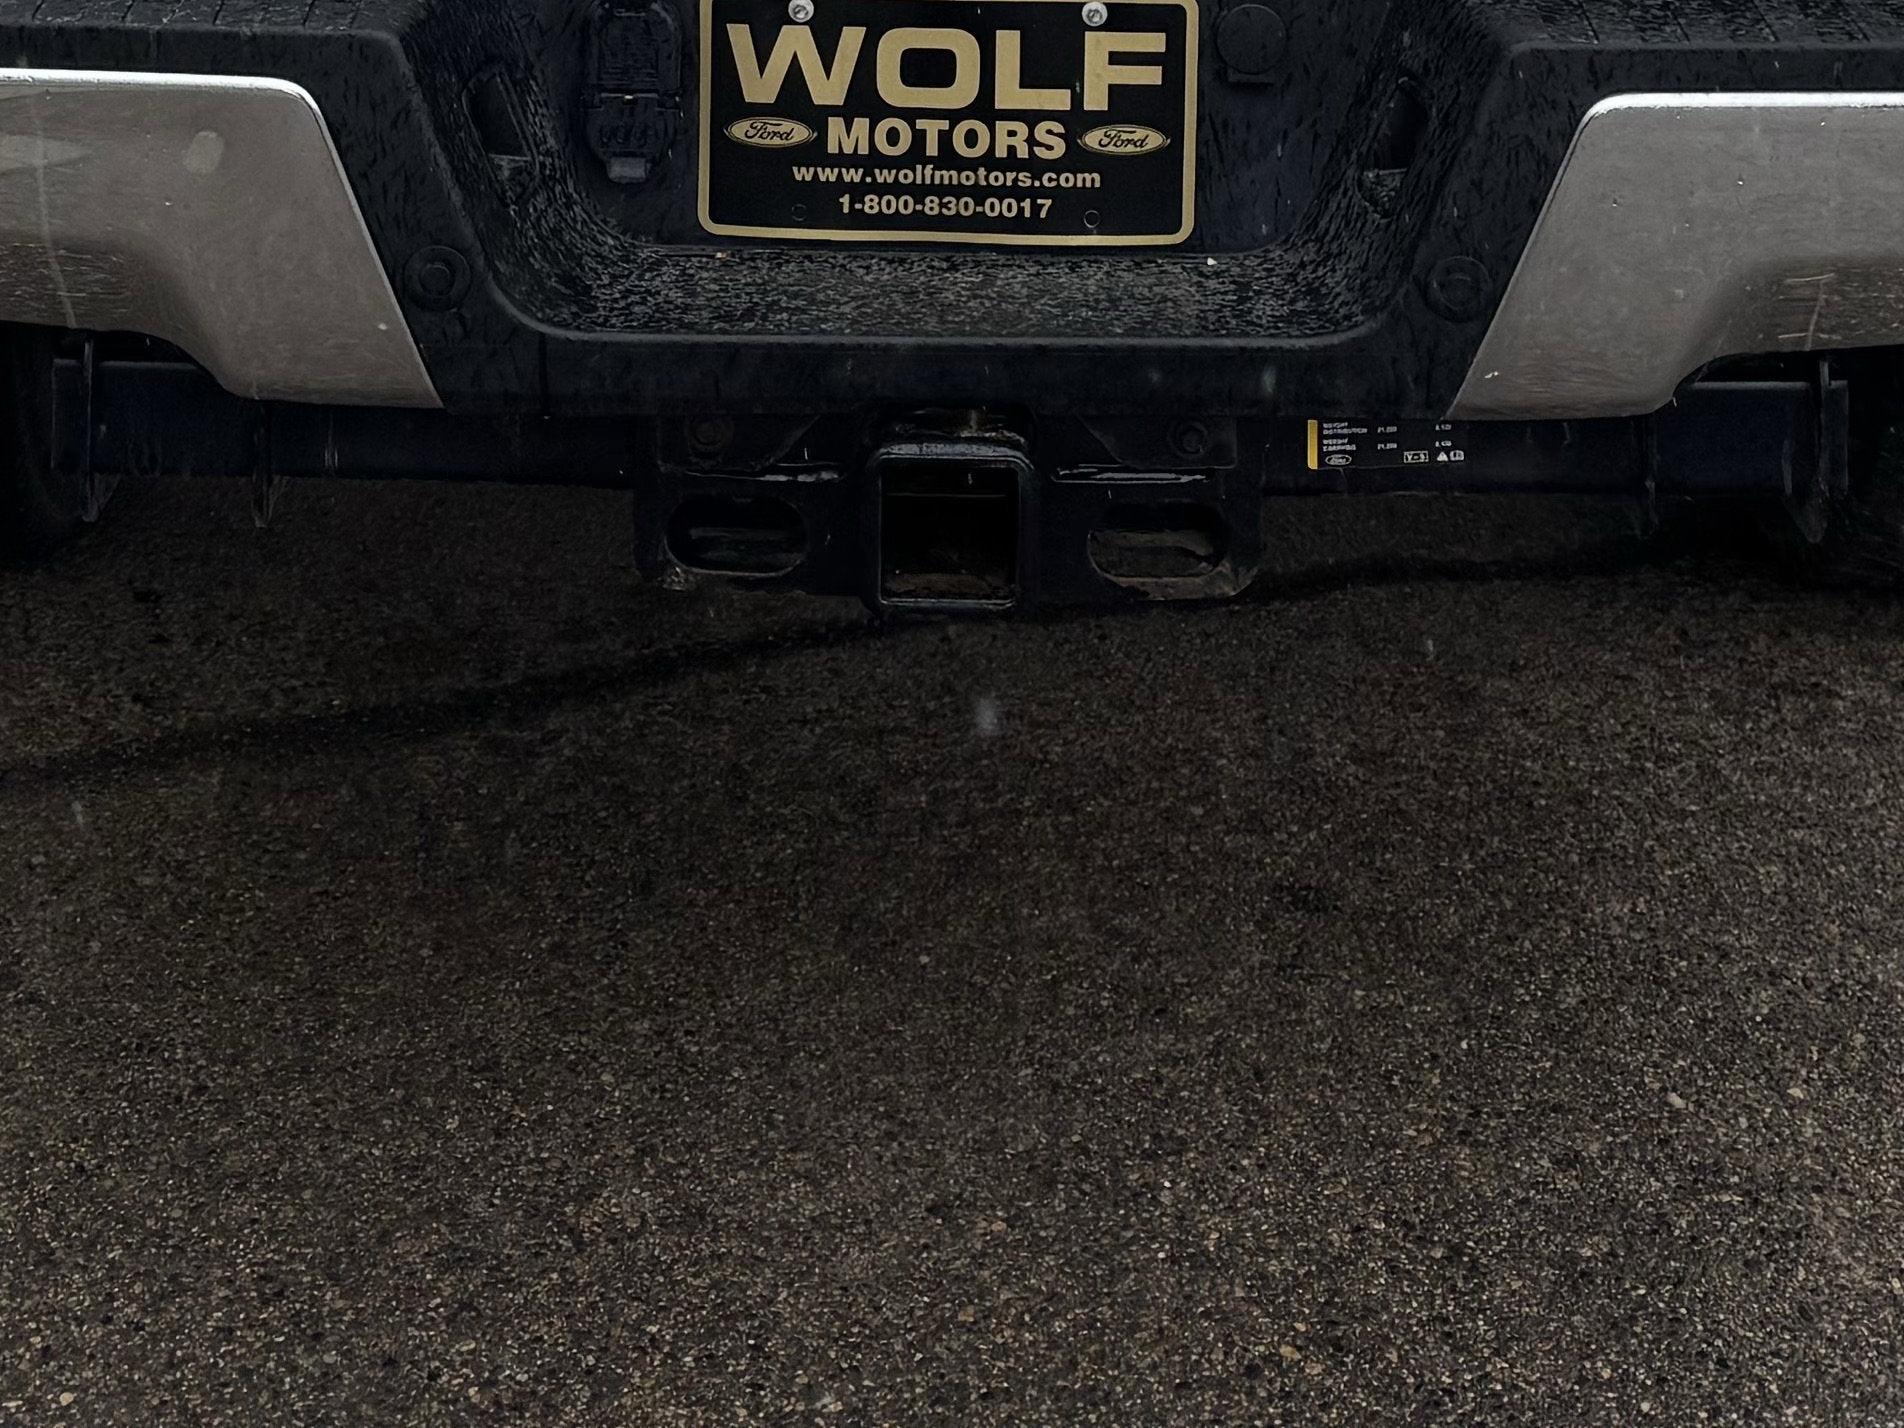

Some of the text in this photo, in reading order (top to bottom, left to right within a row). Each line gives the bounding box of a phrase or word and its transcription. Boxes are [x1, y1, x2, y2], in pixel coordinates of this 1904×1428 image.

[726, 22, 1167, 111] WOLF
[742, 117, 1150, 160] Ford MOTORS Ford
[792, 164, 1102, 189] www.wolfmotors.com
[839, 194, 1053, 220] 1-800-830-0017
